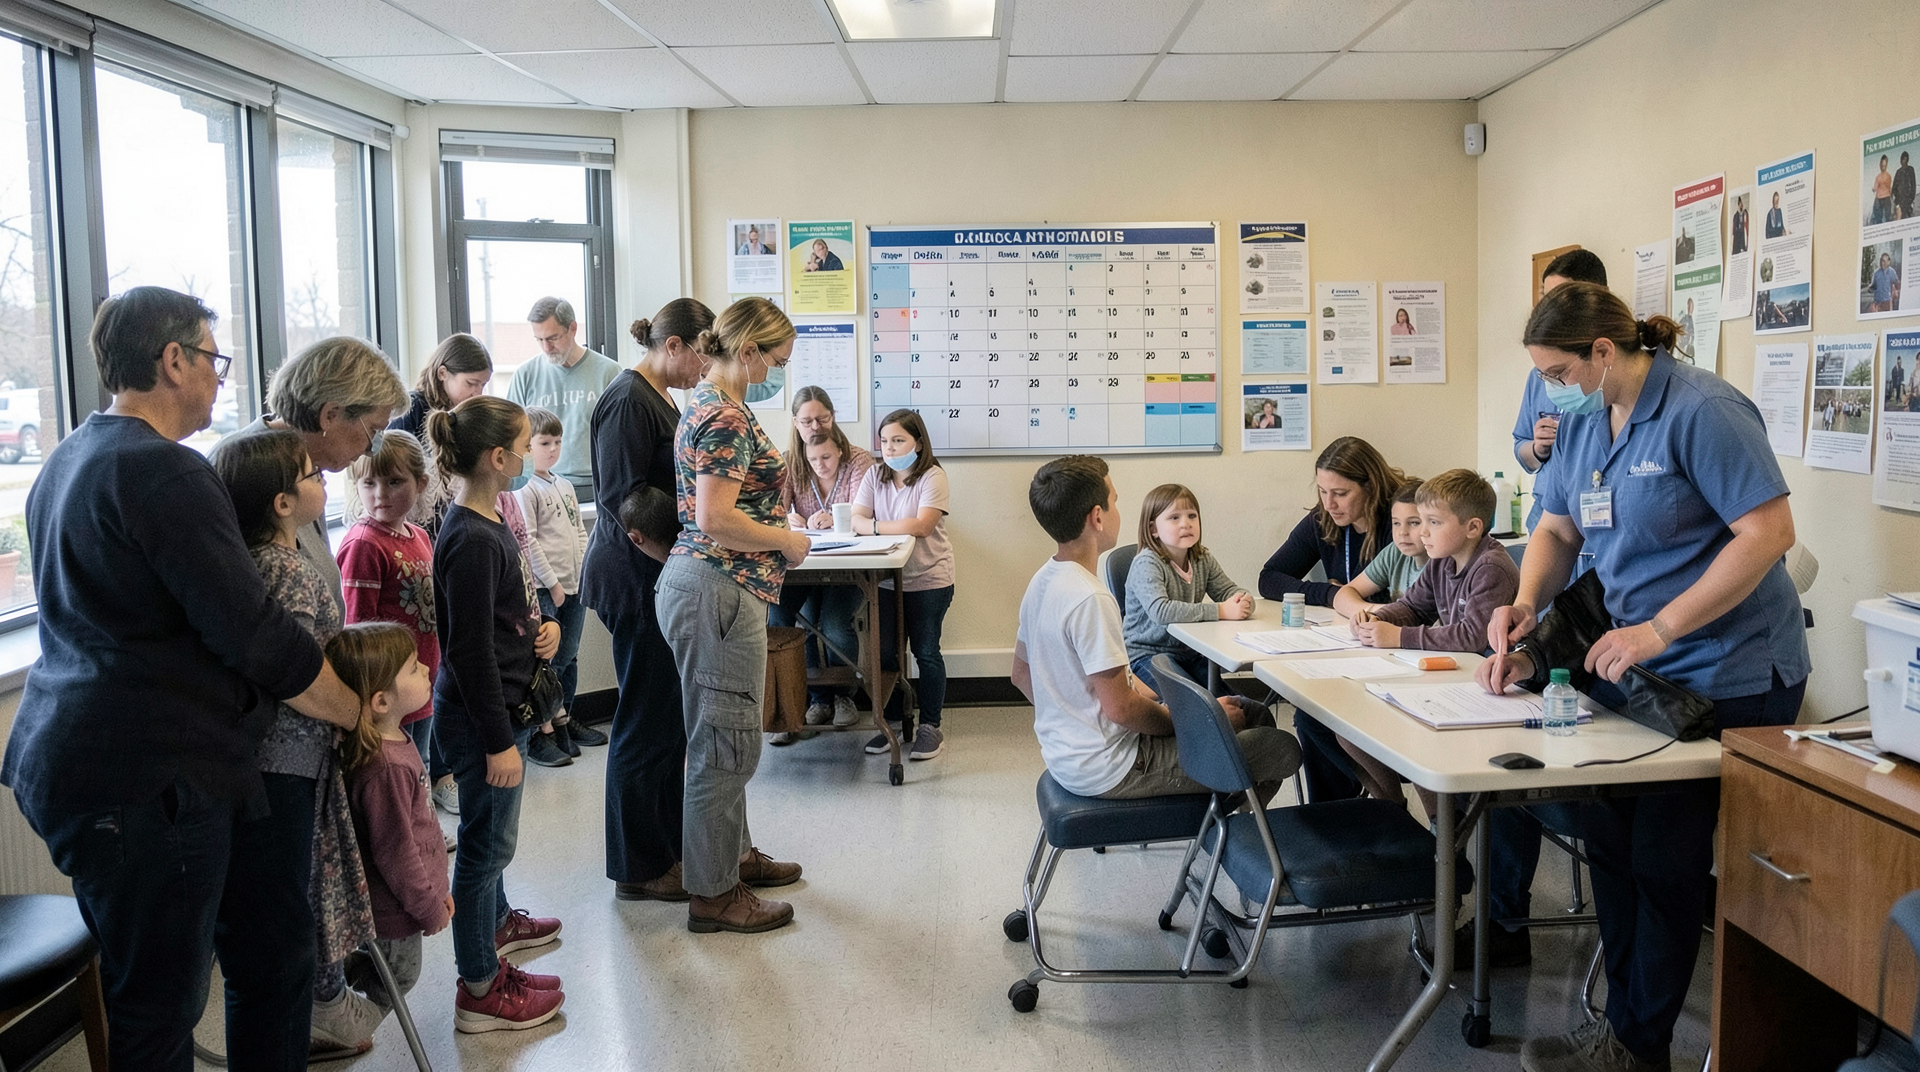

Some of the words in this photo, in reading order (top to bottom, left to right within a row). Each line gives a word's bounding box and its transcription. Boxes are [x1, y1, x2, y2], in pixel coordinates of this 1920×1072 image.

[1108, 264, 1114, 272] 2
[949, 309, 960, 318] 10
[988, 309, 997, 318] 11
[1028, 308, 1039, 318] 10
[1107, 308, 1118, 317] 10
[1107, 351, 1119, 361] 20
